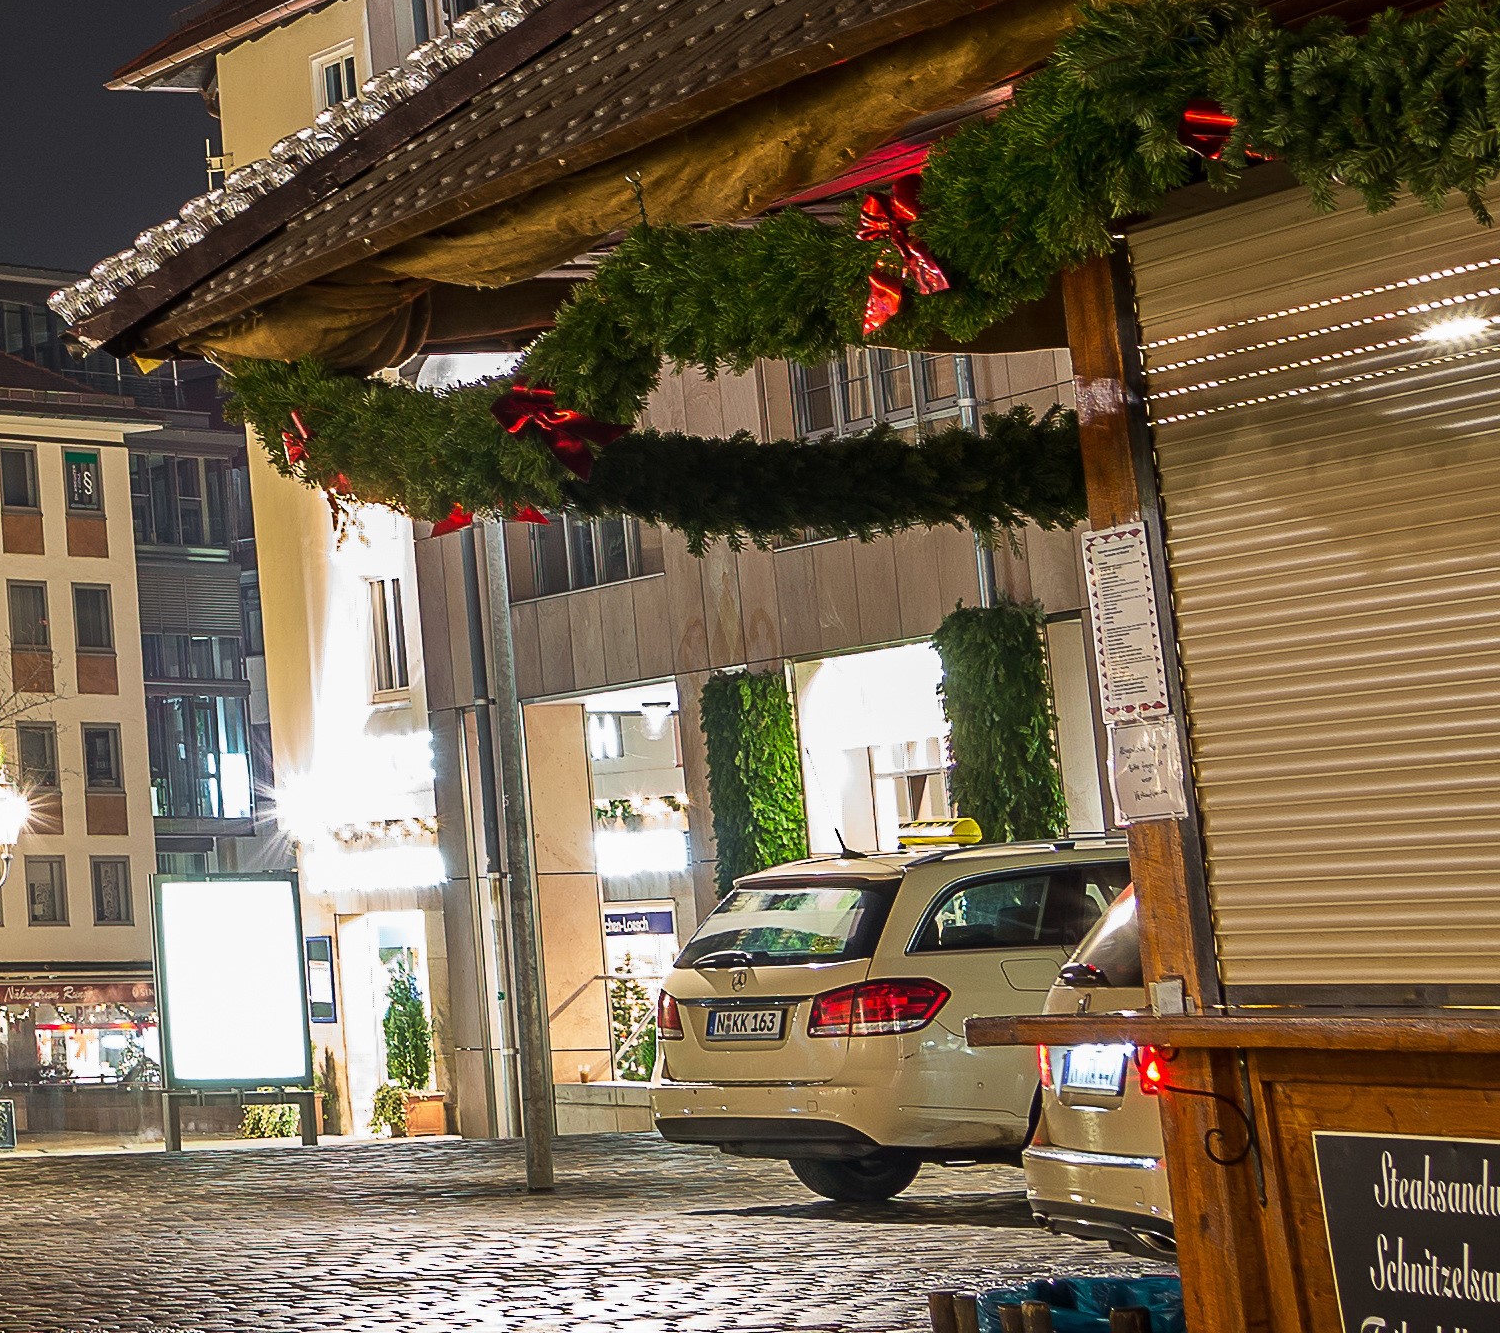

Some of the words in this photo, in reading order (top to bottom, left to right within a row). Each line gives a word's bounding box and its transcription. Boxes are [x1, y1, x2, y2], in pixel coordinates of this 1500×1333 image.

[716, 1013, 726, 1033] N
[732, 1013, 750, 1033] KK
[750, 1013, 777, 1033] 163
[1369, 1233, 1500, 1304] Schnitzelsa
